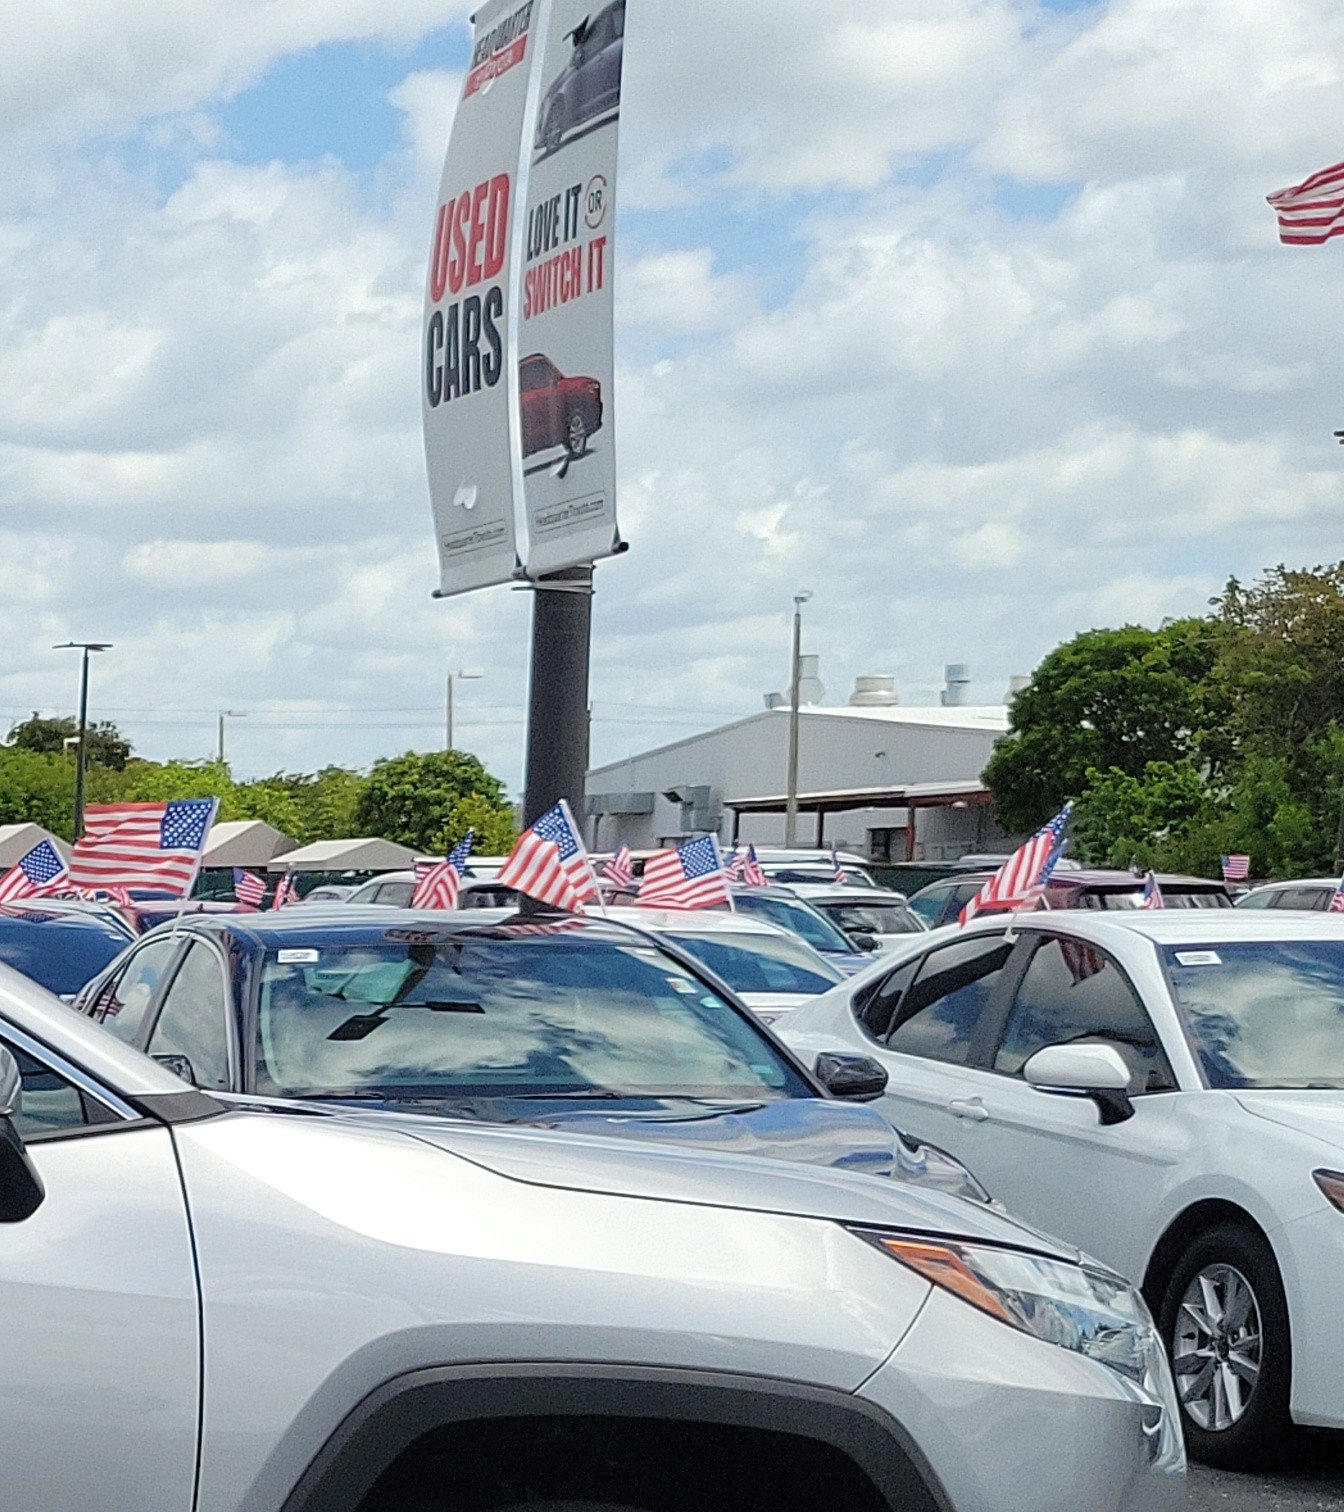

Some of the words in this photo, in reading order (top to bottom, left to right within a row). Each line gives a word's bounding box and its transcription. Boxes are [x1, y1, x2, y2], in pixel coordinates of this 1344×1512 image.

[430, 173, 510, 303] USED
[527, 193, 561, 261] LOVE
[564, 183, 582, 243] IT
[524, 245, 582, 320] SWITCH
[587, 236, 606, 293] IT
[426, 286, 503, 408] CARS
